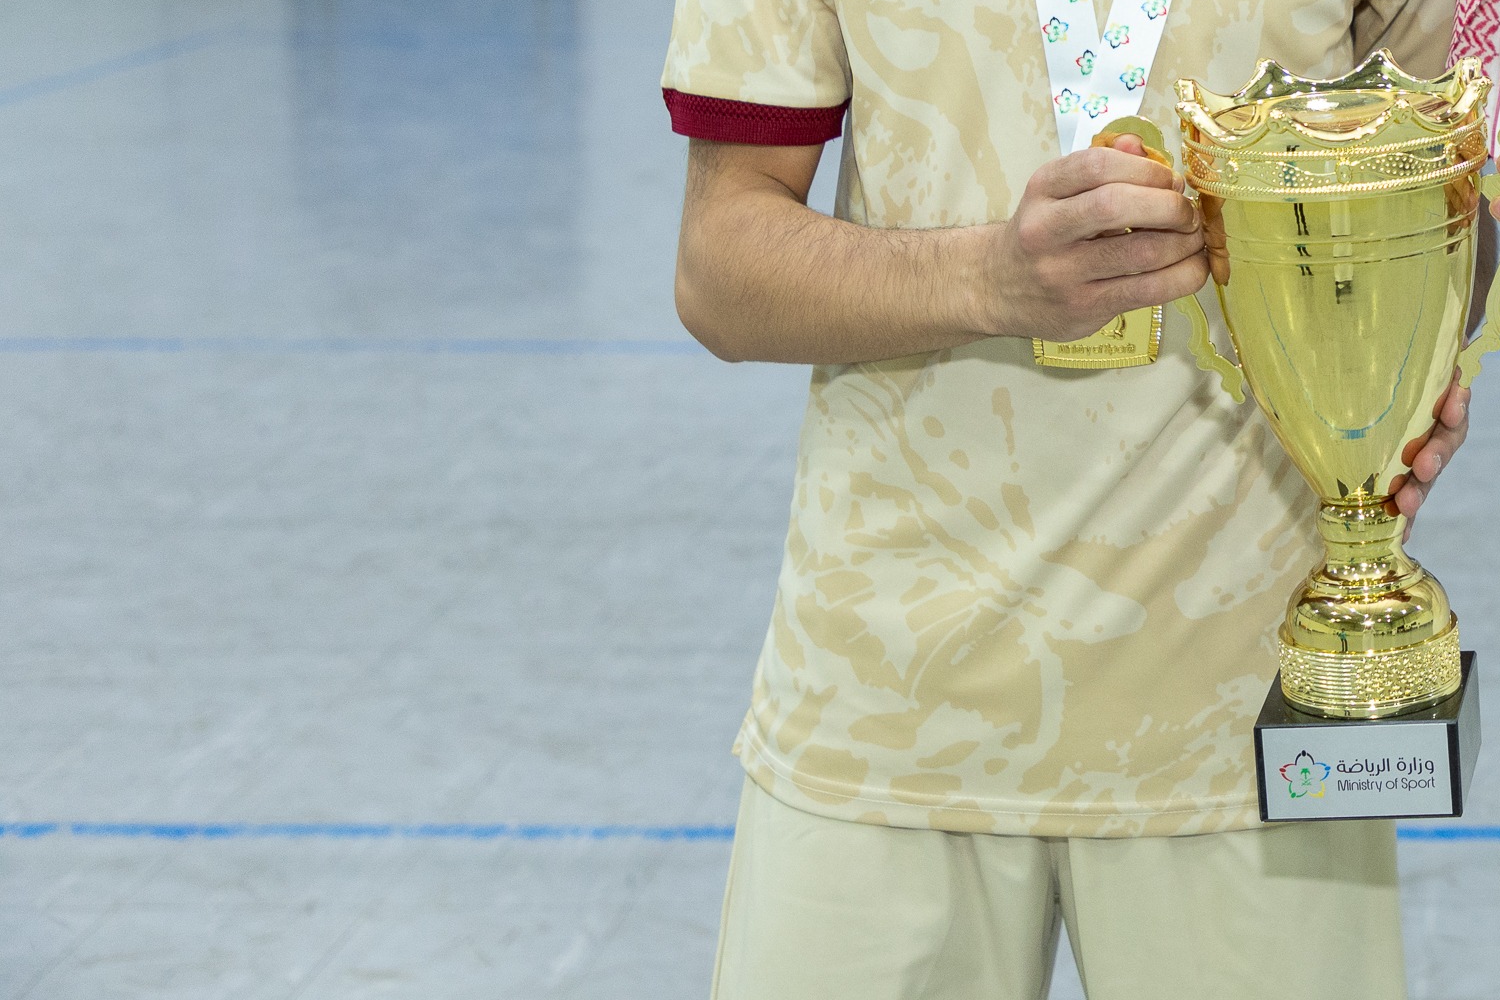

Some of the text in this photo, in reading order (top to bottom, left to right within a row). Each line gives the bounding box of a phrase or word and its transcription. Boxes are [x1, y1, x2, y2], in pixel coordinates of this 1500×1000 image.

[1336, 757, 1434, 776] وزارة الرياضة
[1337, 777, 1435, 793] Ministry of Sport
